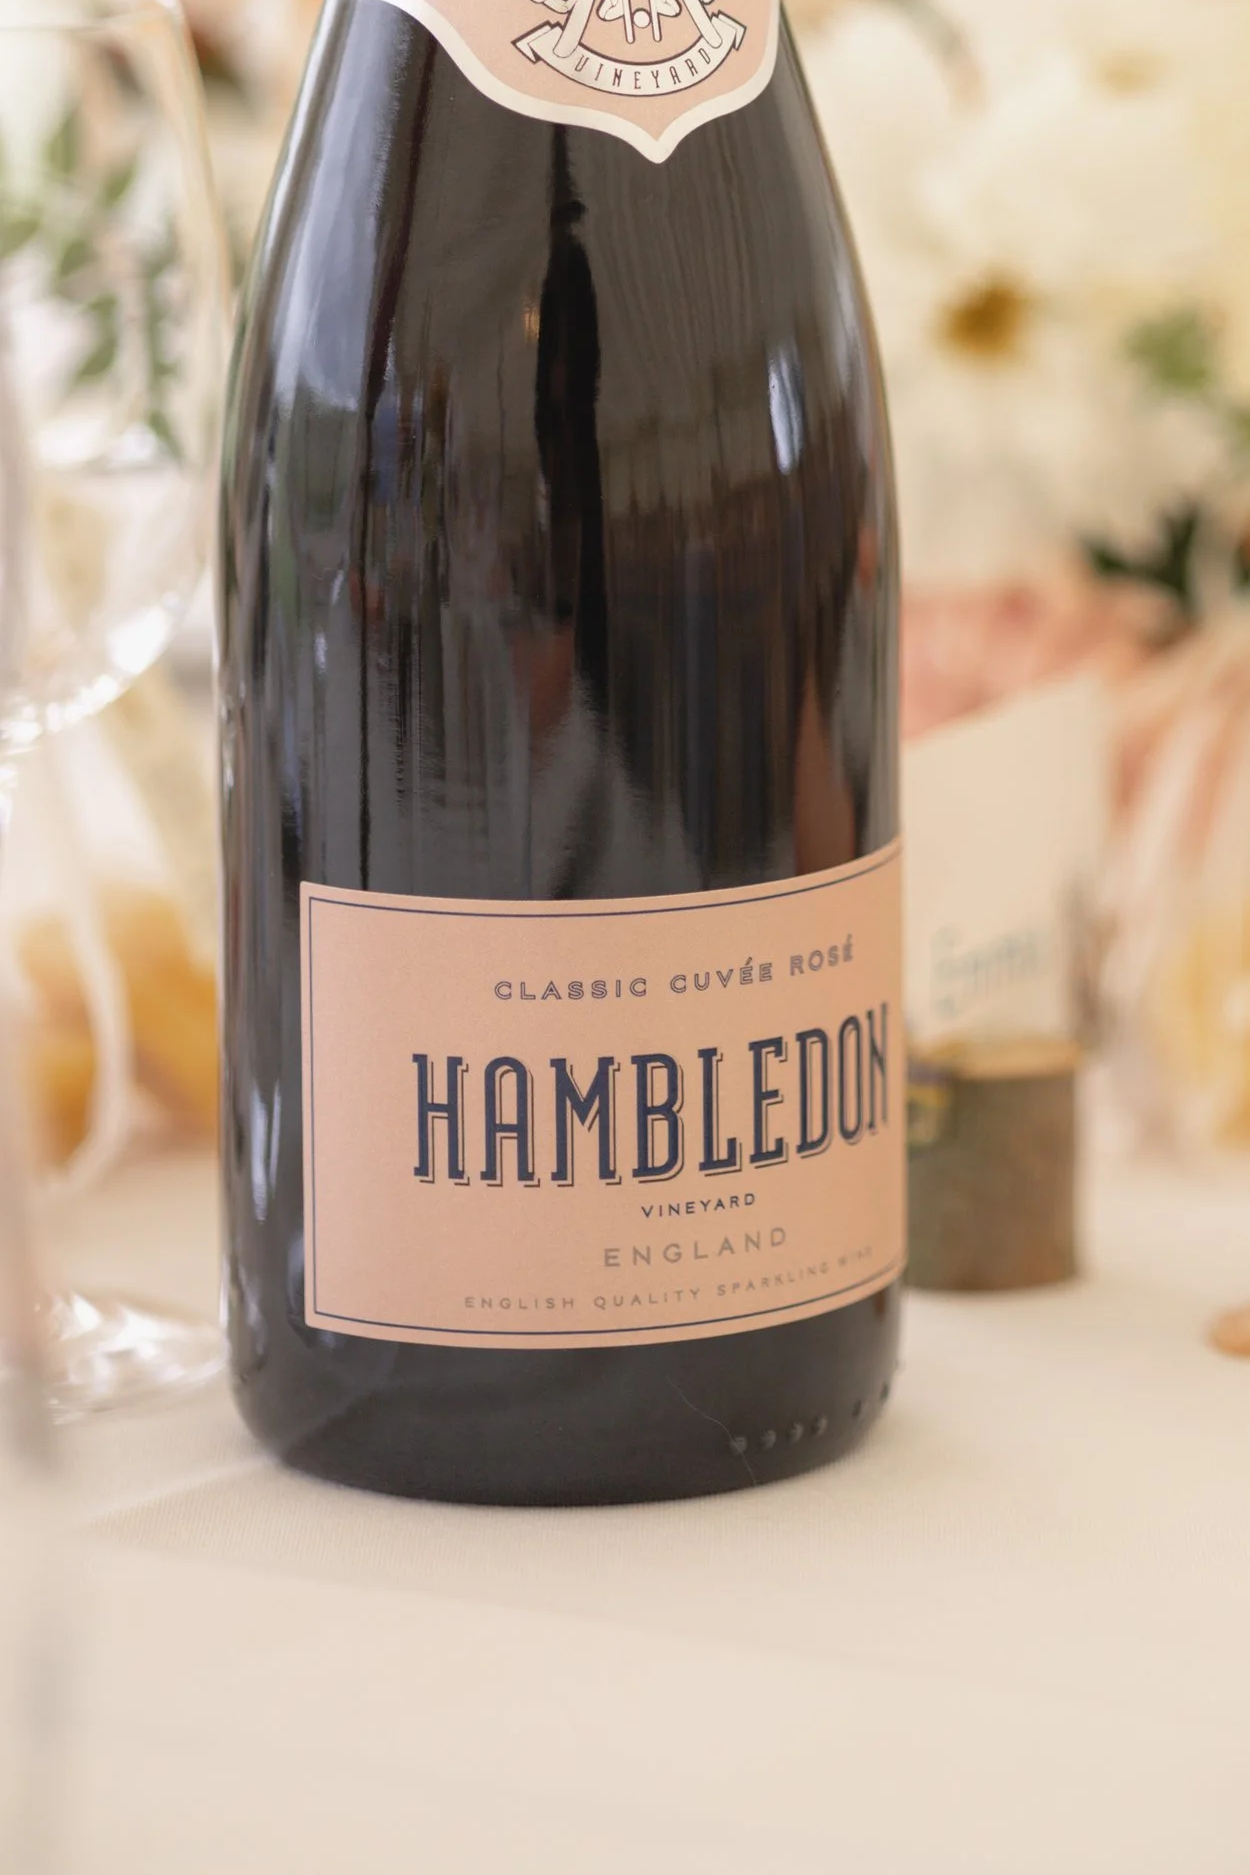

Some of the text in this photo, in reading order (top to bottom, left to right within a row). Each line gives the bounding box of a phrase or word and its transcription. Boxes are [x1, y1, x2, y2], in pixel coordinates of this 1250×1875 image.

[575, 47, 712, 90] VINEYARD
[494, 933, 855, 1001] CLASSIC CUVÉE ROSÉ
[412, 1001, 892, 1188] HAMBLEDON
[641, 1192, 757, 1219] VINEYARD
[603, 1226, 788, 1269] ENGLAND
[464, 1296, 576, 1311] ENGLISH
[594, 1287, 702, 1311] QUALITY
[716, 1260, 830, 1298] SPARKLING
